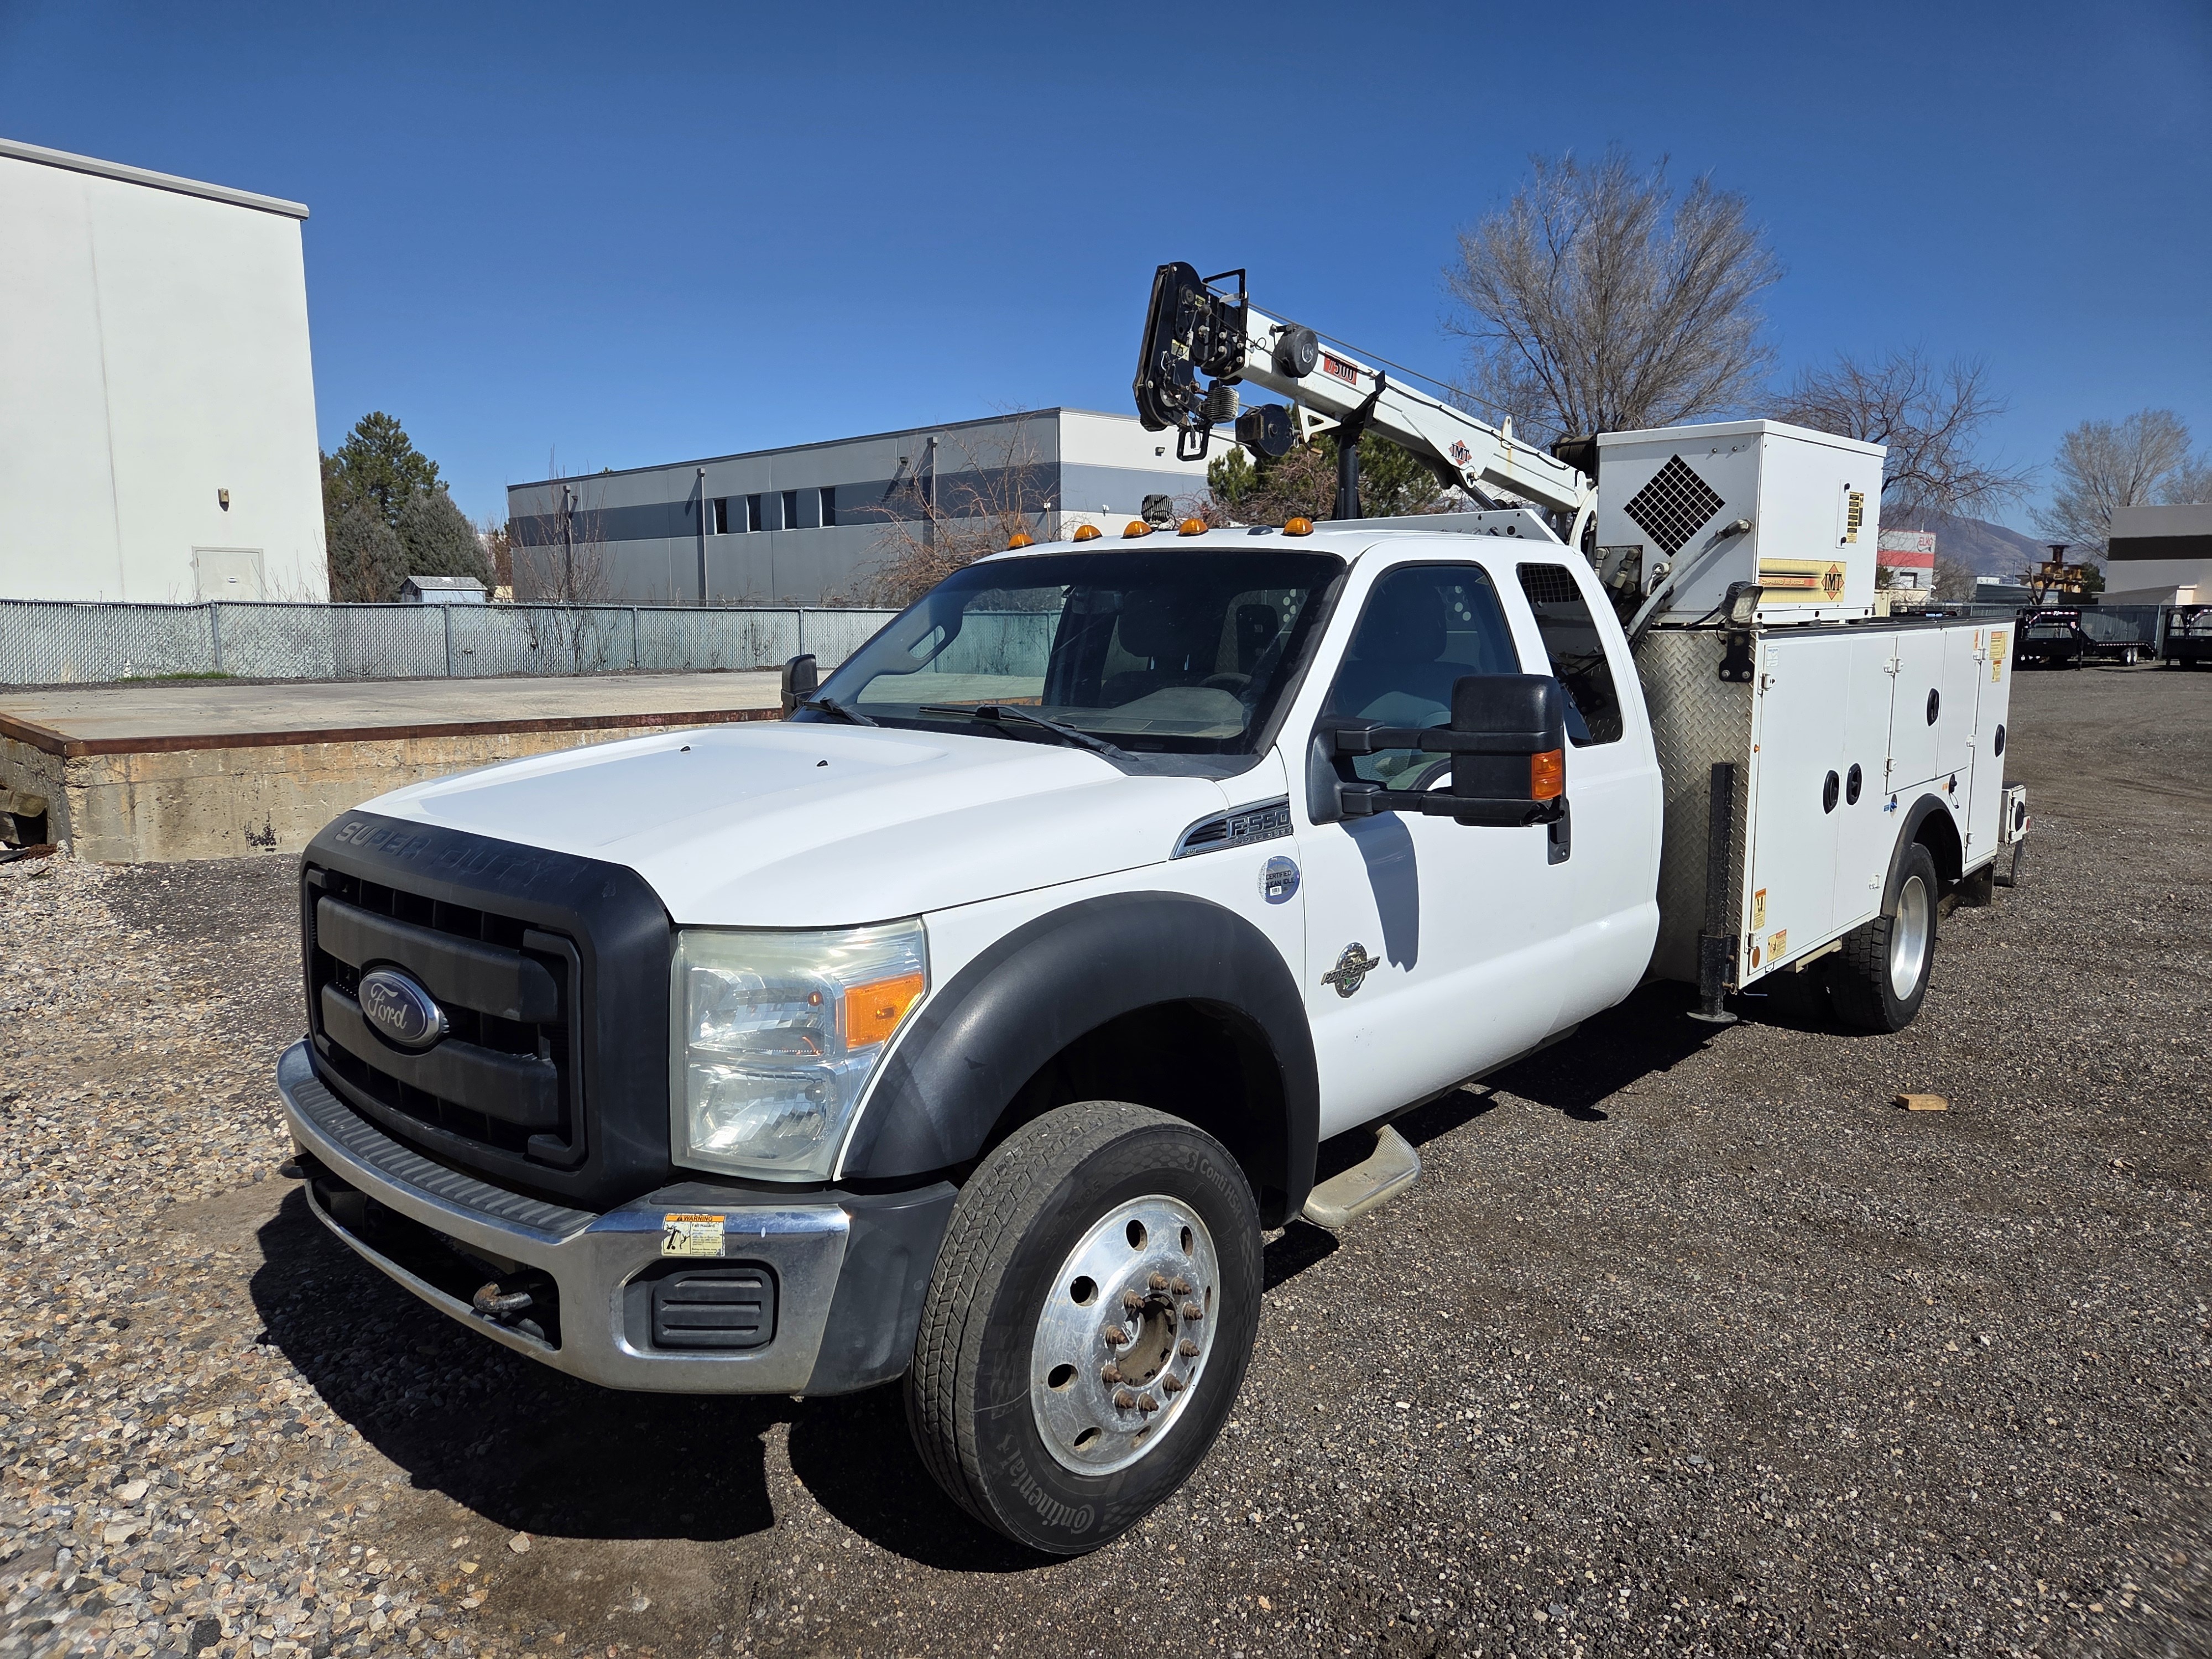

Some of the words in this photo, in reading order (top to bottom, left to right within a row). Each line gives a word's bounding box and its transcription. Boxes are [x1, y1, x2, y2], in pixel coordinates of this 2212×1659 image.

[1451, 443, 1470, 462] IMT
[1823, 573, 1842, 591] IMT
[1232, 834, 1264, 846] SUPER
[1267, 827, 1292, 839] DUTY
[335, 821, 432, 862] SUPER
[430, 843, 561, 888] DUTY
[1266, 870, 1292, 880] CERTIFIED
[368, 983, 408, 1030] Ford
[1199, 1158, 1228, 1192] Conti
[1223, 1188, 1243, 1219] HSR
[1238, 1215, 1246, 1229] 5
[999, 1446, 1095, 1535] Continental
